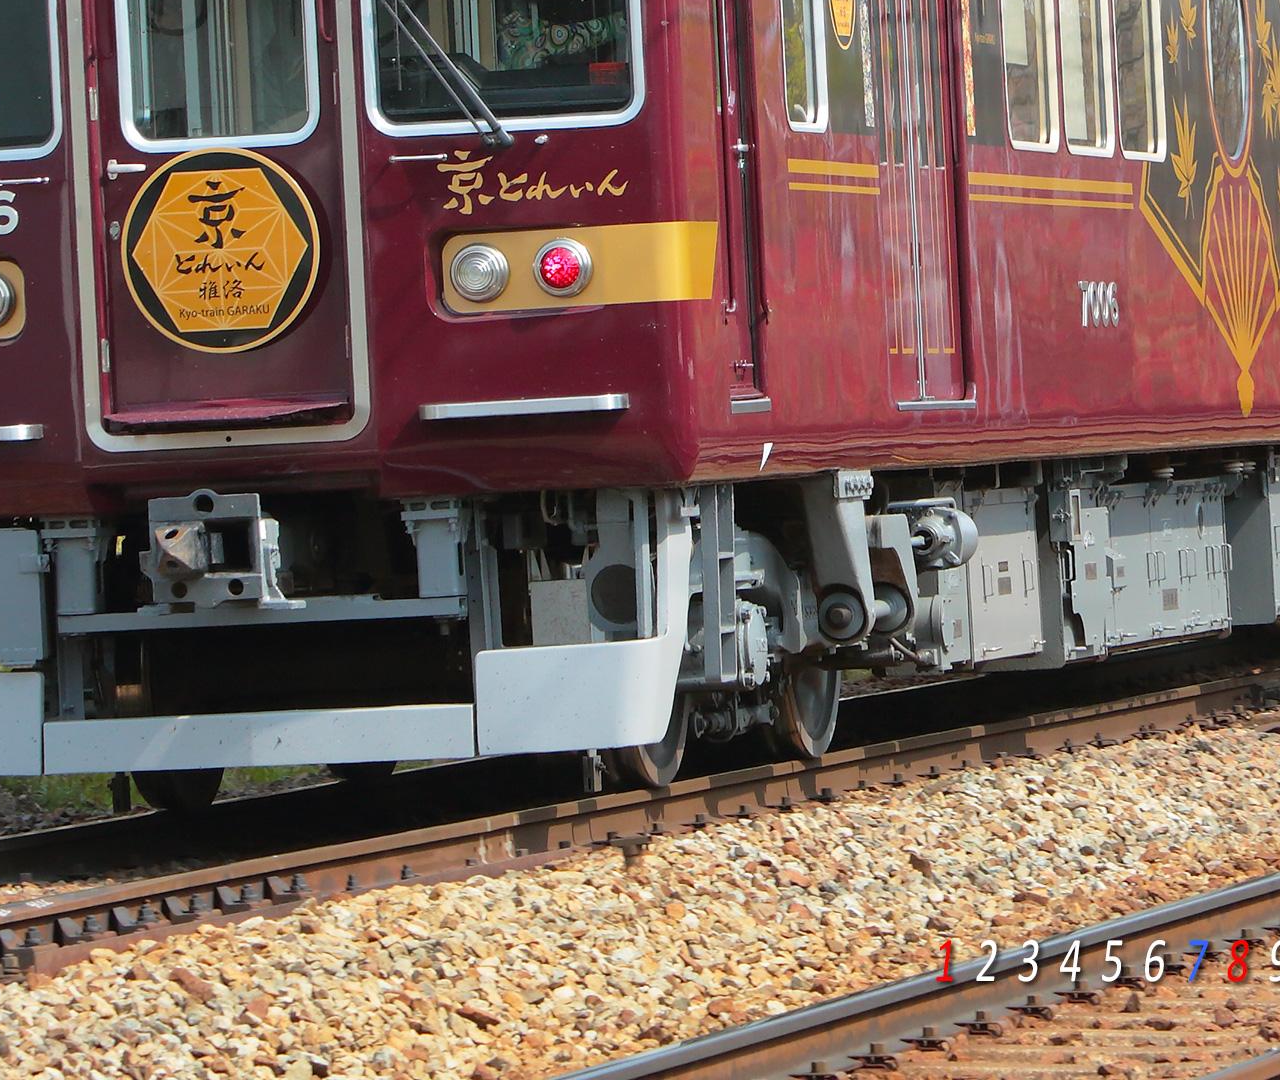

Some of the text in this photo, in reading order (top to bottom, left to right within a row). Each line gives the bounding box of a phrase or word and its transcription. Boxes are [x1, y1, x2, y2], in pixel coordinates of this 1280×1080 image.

[436, 149, 629, 215] 京とれいん
[187, 180, 248, 250] 京
[175, 251, 267, 275] とれいん
[198, 278, 246, 301] 雅洛
[1077, 280, 1120, 328] 7006
[178, 303, 271, 321] Kyo-train GARAKU
